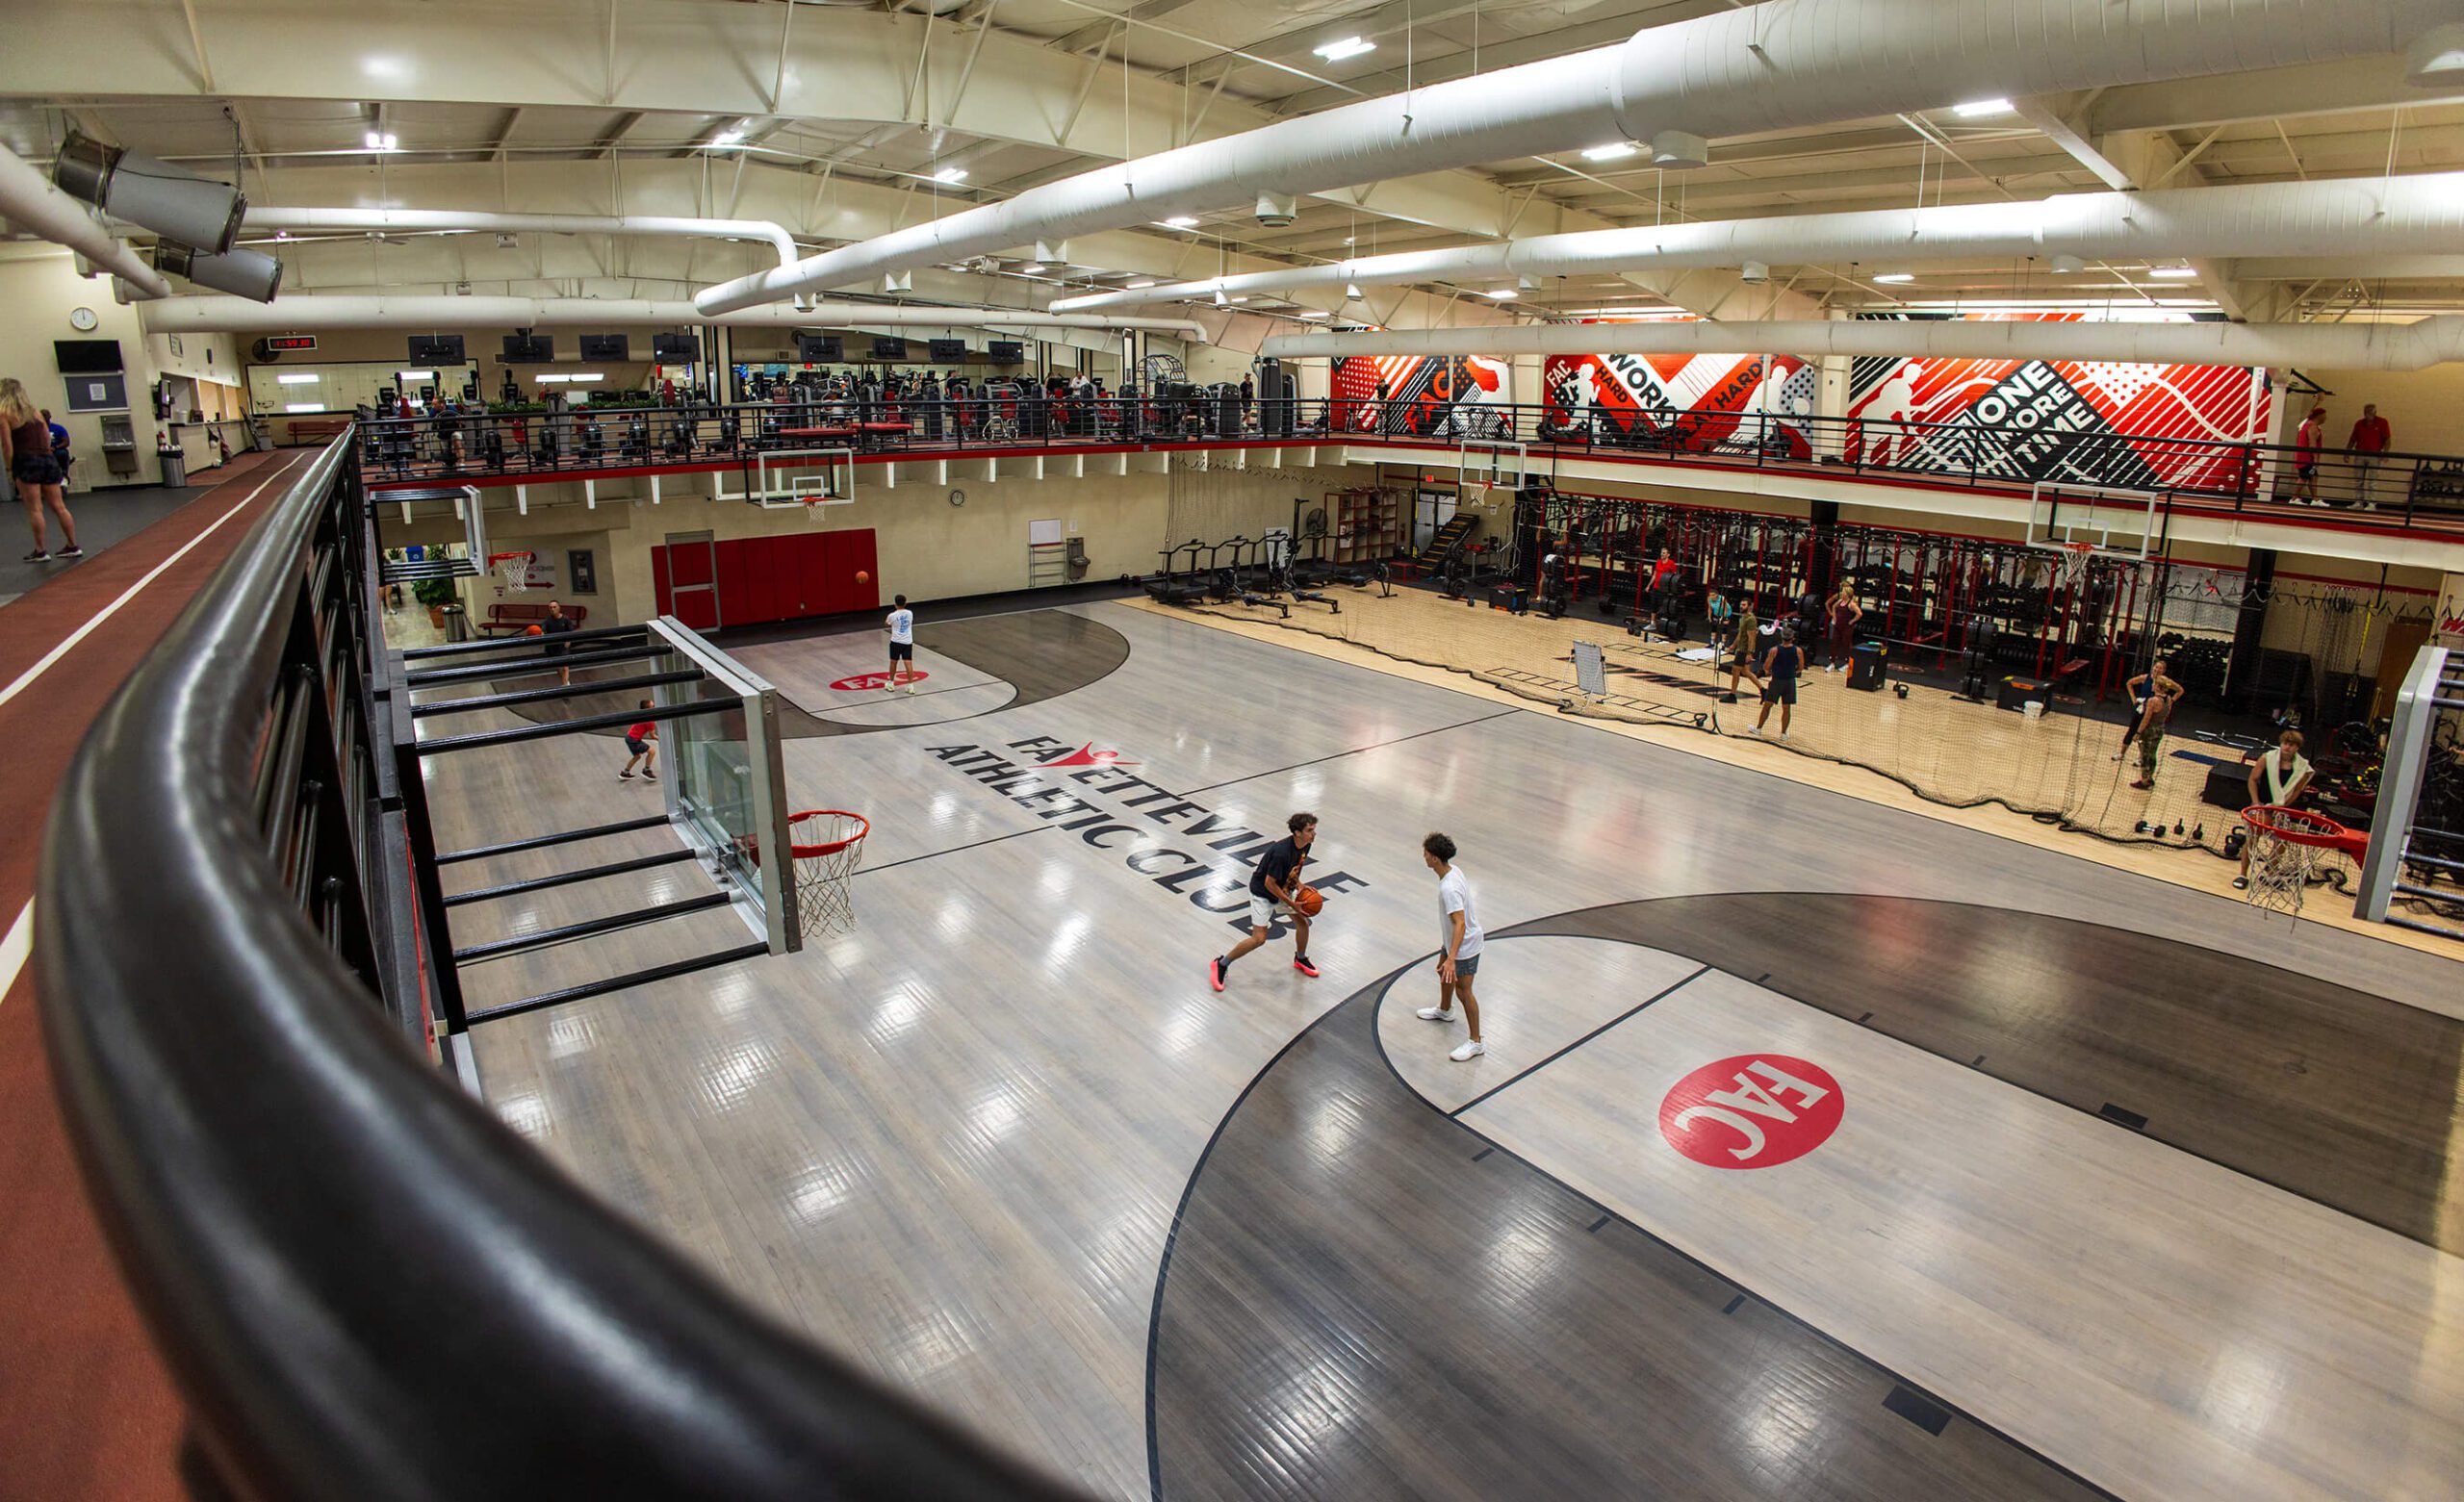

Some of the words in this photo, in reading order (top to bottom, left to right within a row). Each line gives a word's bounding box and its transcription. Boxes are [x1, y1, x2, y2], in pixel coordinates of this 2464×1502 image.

[1546, 359, 1572, 389] FAC
[1596, 366, 1629, 403] HARD
[1977, 360, 2056, 424] ONE
[1994, 382, 2073, 446] MORE
[2013, 401, 2096, 464] TIME
[924, 744, 1149, 850] ATHLETIC
[1126, 848, 1313, 941] CLUB
[1674, 1059, 1830, 1160] FAC
